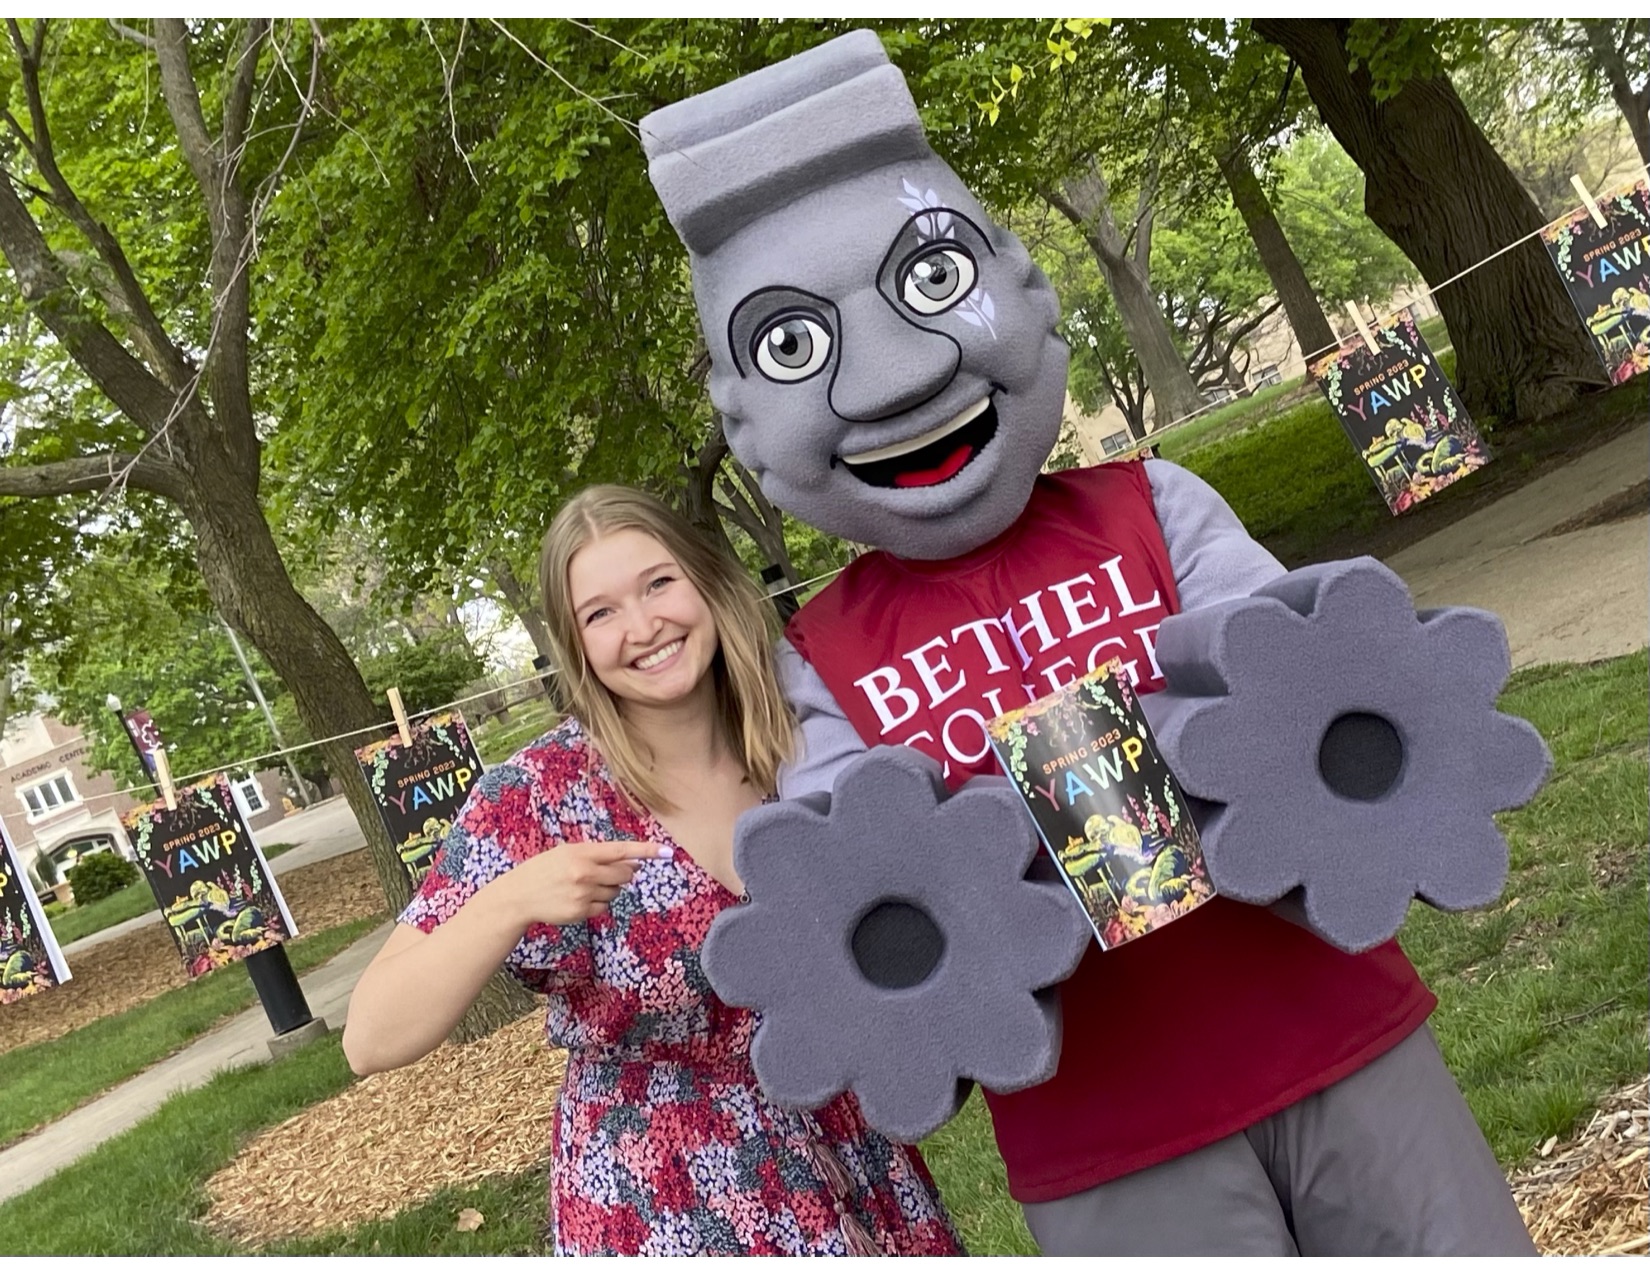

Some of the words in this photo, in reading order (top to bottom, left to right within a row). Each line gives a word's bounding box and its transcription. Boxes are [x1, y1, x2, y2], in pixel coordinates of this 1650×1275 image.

[1583, 241, 1617, 263] SPRING
[1618, 228, 1642, 246] 2023
[1347, 363, 1427, 421] YAWP
[1353, 373, 1386, 396] SPRING
[1386, 359, 1410, 377] 2023
[853, 555, 1161, 736] BETHEL
[11, 761, 52, 783] ACADEMIC
[397, 769, 431, 788] SPRING
[432, 760, 456, 775] 2023
[1034, 736, 1143, 812] YAWP
[1042, 747, 1088, 775] SPRING
[1090, 728, 1121, 753] 2023
[388, 767, 472, 815] YAWP
[154, 830, 236, 879] YAWP
[163, 832, 196, 852] SPRING
[198, 822, 221, 838] 2023
